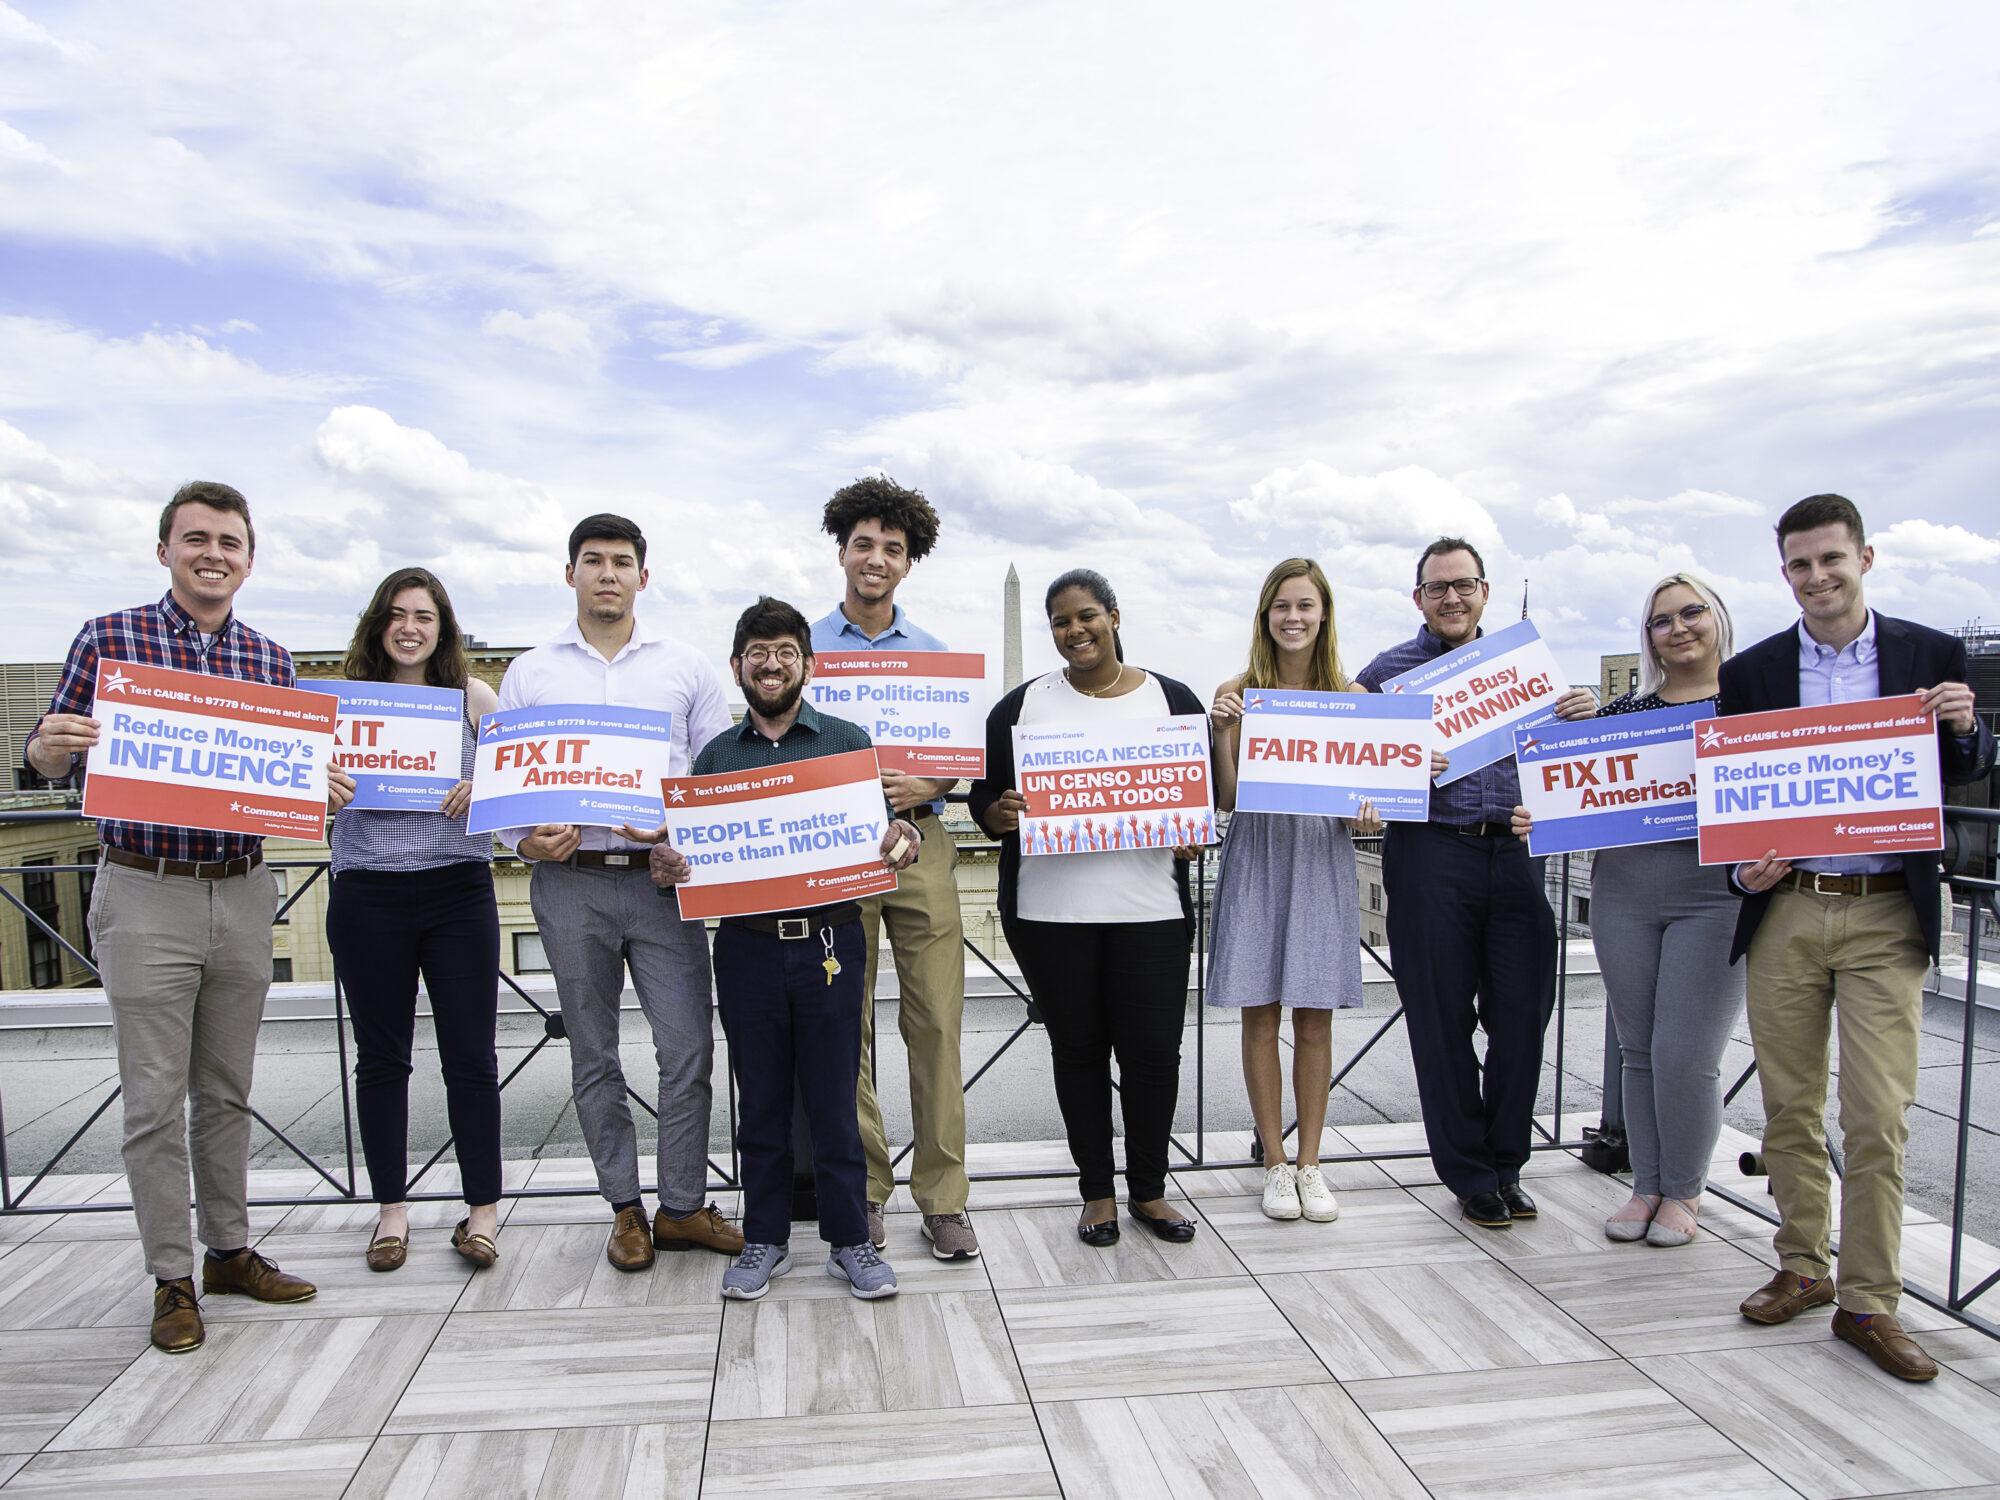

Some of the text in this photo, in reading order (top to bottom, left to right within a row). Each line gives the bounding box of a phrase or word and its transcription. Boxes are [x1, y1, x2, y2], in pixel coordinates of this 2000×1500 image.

[881, 661, 908, 669] 97779
[1409, 651, 1480, 687] Text CAUSE to 97779
[811, 685, 970, 703] The Politicians
[1434, 666, 1520, 715] e're Busy
[130, 685, 329, 722] Text CAUSE to 97779 for news and alerts
[351, 698, 379, 706] 97779
[434, 704, 457, 712] alerts
[881, 707, 899, 716] vs.
[1289, 701, 1318, 709] CAUSE
[1435, 672, 1554, 738] WINNING!
[501, 725, 517, 733] Text
[518, 720, 545, 730] CAUSE
[601, 720, 622, 728] news
[642, 724, 665, 733] alerts
[876, 721, 950, 742] People
[1525, 713, 1553, 729] Common
[1722, 715, 1926, 745] Text CAUSE to 97779 for news and alerts
[113, 713, 208, 743] Reduce
[215, 728, 313, 759] Money's
[352, 720, 384, 746] IT
[1029, 733, 1061, 741] Common
[1541, 742, 1558, 751] Text
[1559, 738, 1589, 748] CAUSE
[1601, 731, 1629, 742] 97779
[1630, 730, 1642, 738] for
[1644, 726, 1666, 735] news
[1668, 724, 1684, 732] and
[109, 739, 312, 789] INFLUENCE
[495, 740, 590, 771] FIX IT
[917, 753, 980, 762] Common Cause
[1022, 742, 1204, 767] AMERICA NECESITA
[1248, 738, 1423, 768] FAIR MAPS
[1714, 747, 1915, 782] Reduce Money's
[523, 767, 642, 789] America!
[1026, 766, 1203, 792] UN CENSO JUSTO
[1542, 753, 1638, 792] FIX IT
[388, 786, 427, 794] Common
[693, 775, 794, 796] Text CAUSE to 97779
[1715, 771, 1918, 814] INFLUENCE
[591, 801, 660, 815] Common Cause
[1050, 786, 1183, 810] PARA TODOS
[1397, 796, 1423, 804] Cause
[243, 806, 319, 821] Common Cause
[1654, 814, 1694, 824] Common
[676, 812, 847, 845] PEOPLE matter
[1848, 822, 1934, 834] Common Cause
[738, 843, 784, 861] than
[789, 821, 880, 854] MONEY
[819, 874, 860, 886] Common
